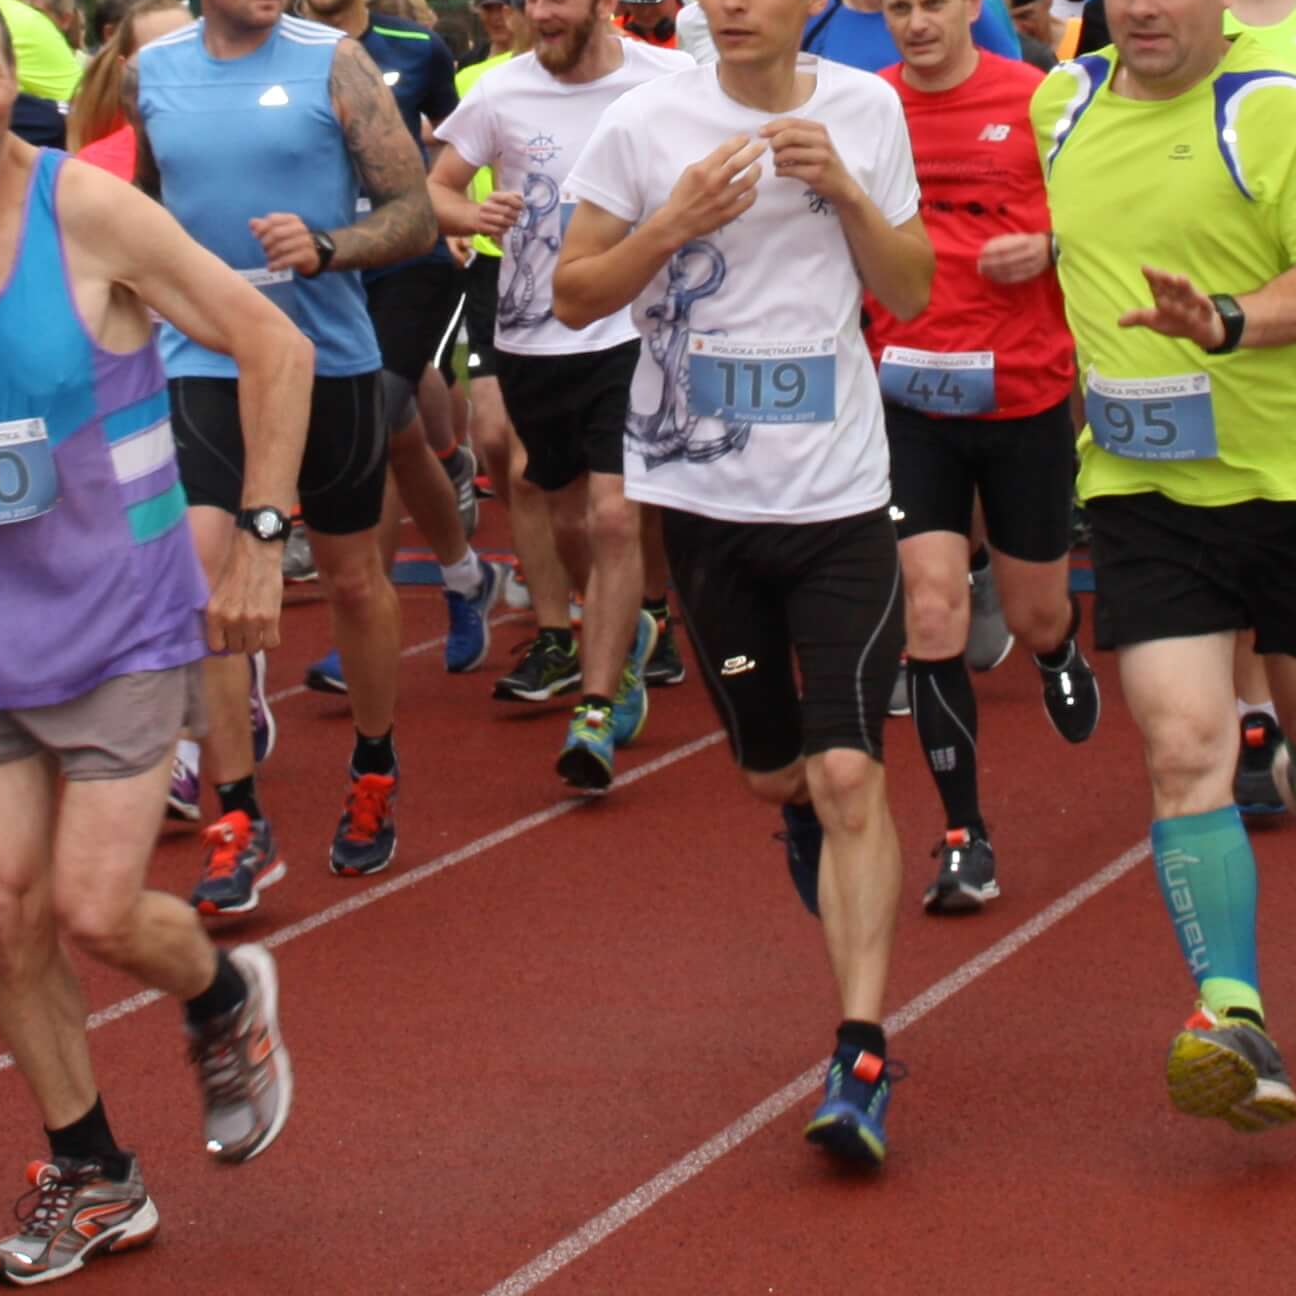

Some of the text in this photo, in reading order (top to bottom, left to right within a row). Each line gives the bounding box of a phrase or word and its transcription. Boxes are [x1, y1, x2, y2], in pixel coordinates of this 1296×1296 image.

[717, 361, 806, 408] 119
[907, 369, 964, 404] 44
[1105, 401, 1177, 446] 95
